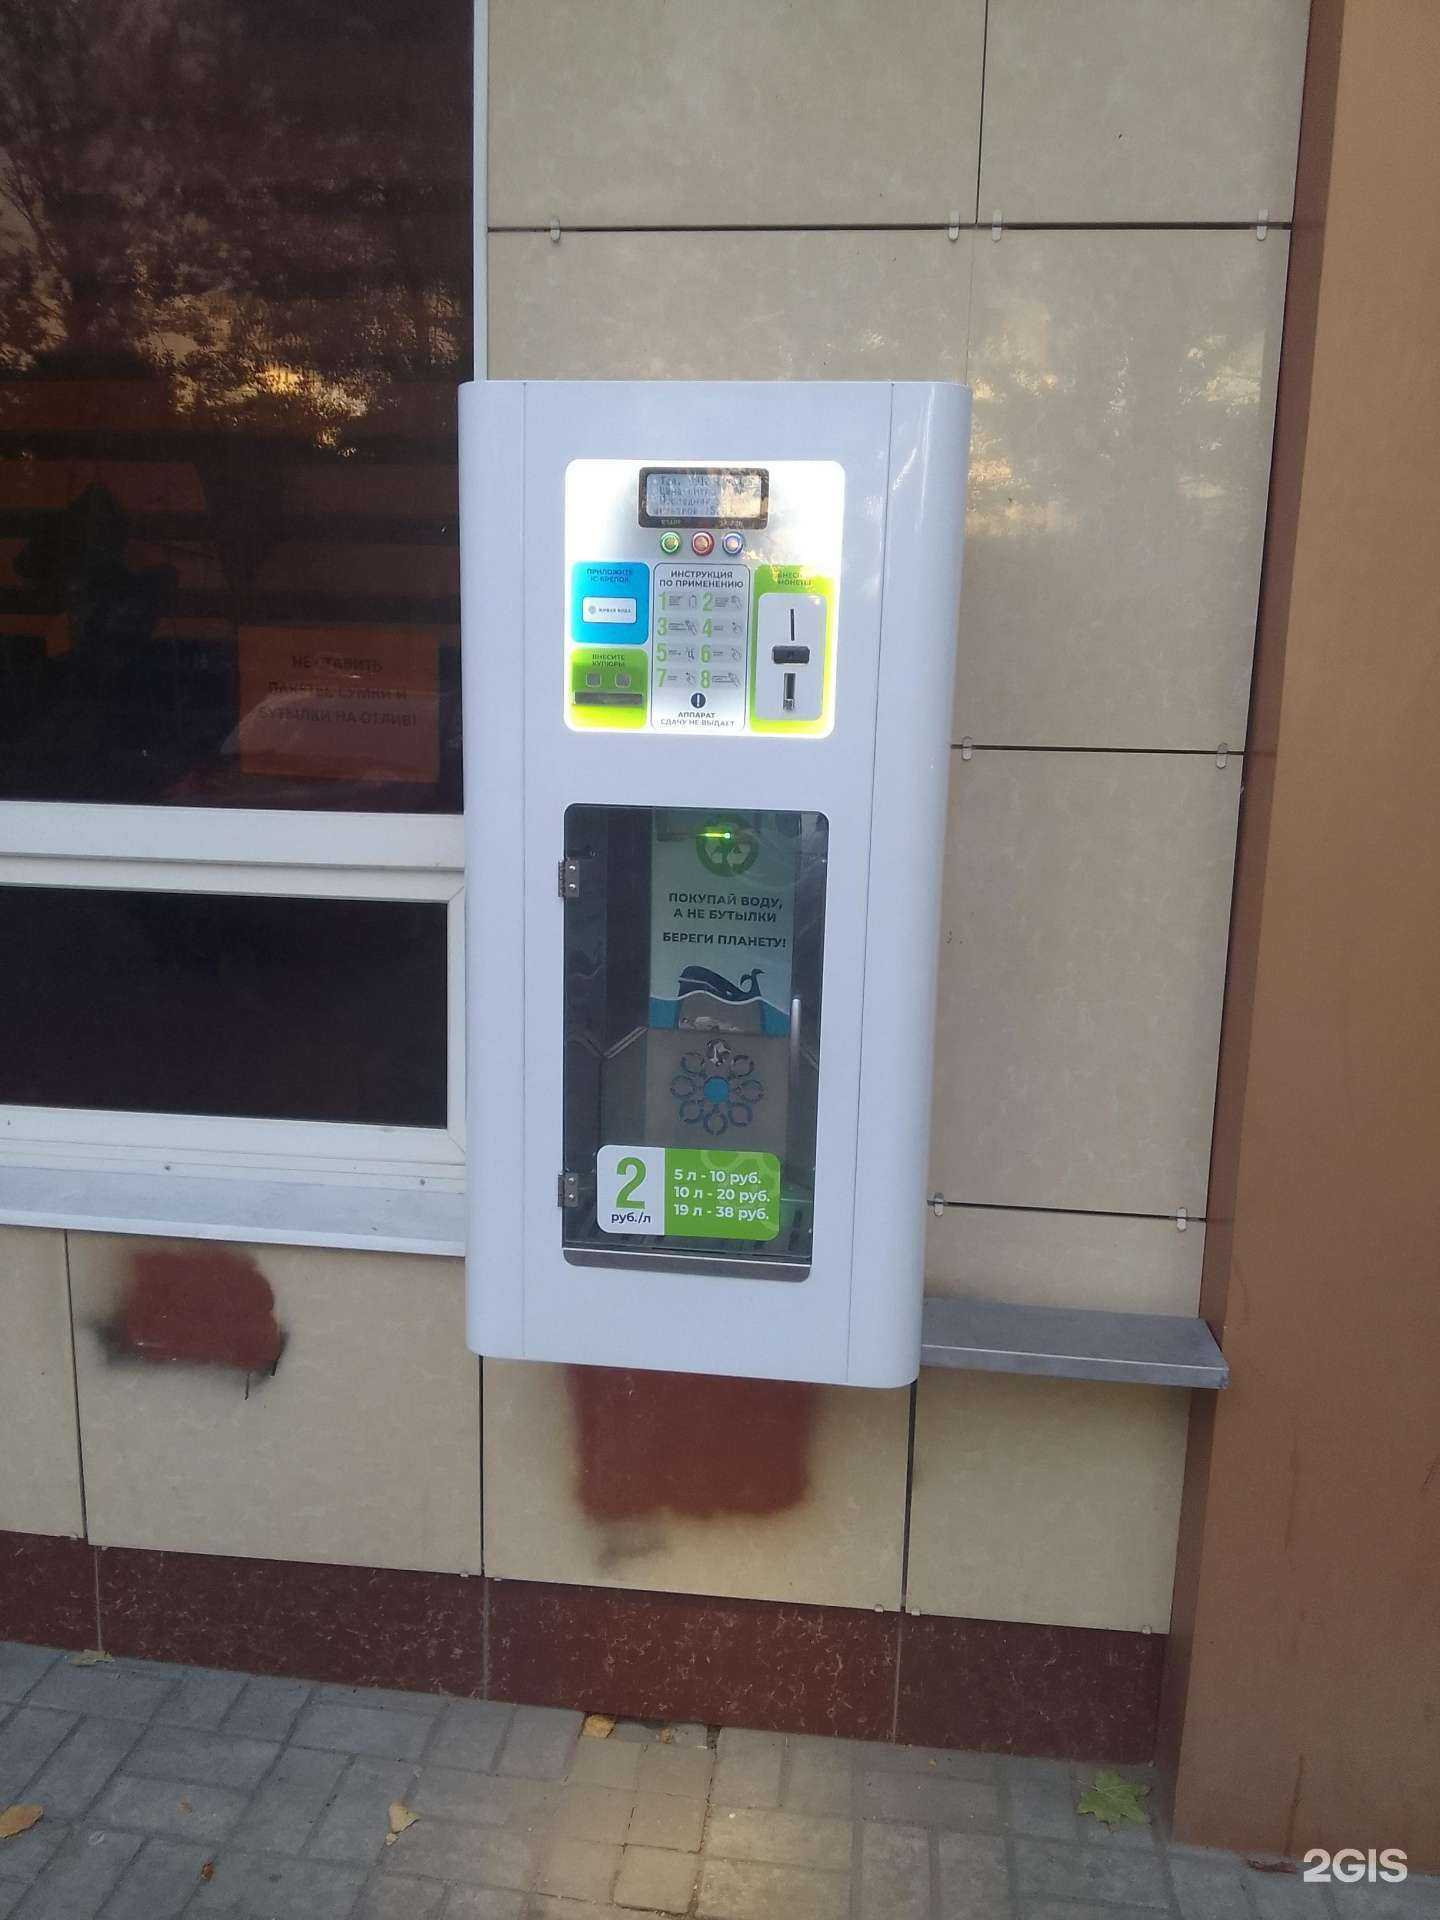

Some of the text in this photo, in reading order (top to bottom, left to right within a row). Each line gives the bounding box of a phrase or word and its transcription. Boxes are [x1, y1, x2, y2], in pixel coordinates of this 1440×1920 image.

[660, 579, 744, 589] ПО ПРИМЕНЕНИЮ
[671, 571, 733, 579] ИНСТРУКЦИЯ
[658, 592, 667, 610] 1
[702, 592, 713, 611] 2
[657, 617, 668, 636] 3
[702, 618, 712, 638] 4
[656, 643, 667, 662] 5
[701, 644, 711, 663] 6
[656, 668, 668, 687] 7
[701, 670, 711, 689] 8
[660, 718, 687, 726] СДАЧУ
[678, 711, 715, 719] АППАРАТ
[669, 892, 783, 910] ПОКУПАЙ ВОДУ,
[673, 908, 776, 922] А НЕ БУТЫЛКИ
[663, 932, 786, 948] БЕРЕГИ ПЛАНЕТУ!
[615, 1156, 647, 1209] 2
[674, 1169, 683, 1180] 5
[686, 1172, 697, 1181] л
[710, 1170, 726, 1182] 10
[730, 1172, 761, 1185] руб.
[674, 1186, 690, 1198] 10
[692, 1189, 703, 1199] л
[716, 1188, 735, 1200] 20
[739, 1190, 771, 1203] руб.
[611, 1212, 651, 1223] руб./л
[674, 1204, 689, 1216] 19
[692, 1207, 702, 1216] л
[715, 1206, 734, 1218] 38
[738, 1208, 769, 1222] руб.
